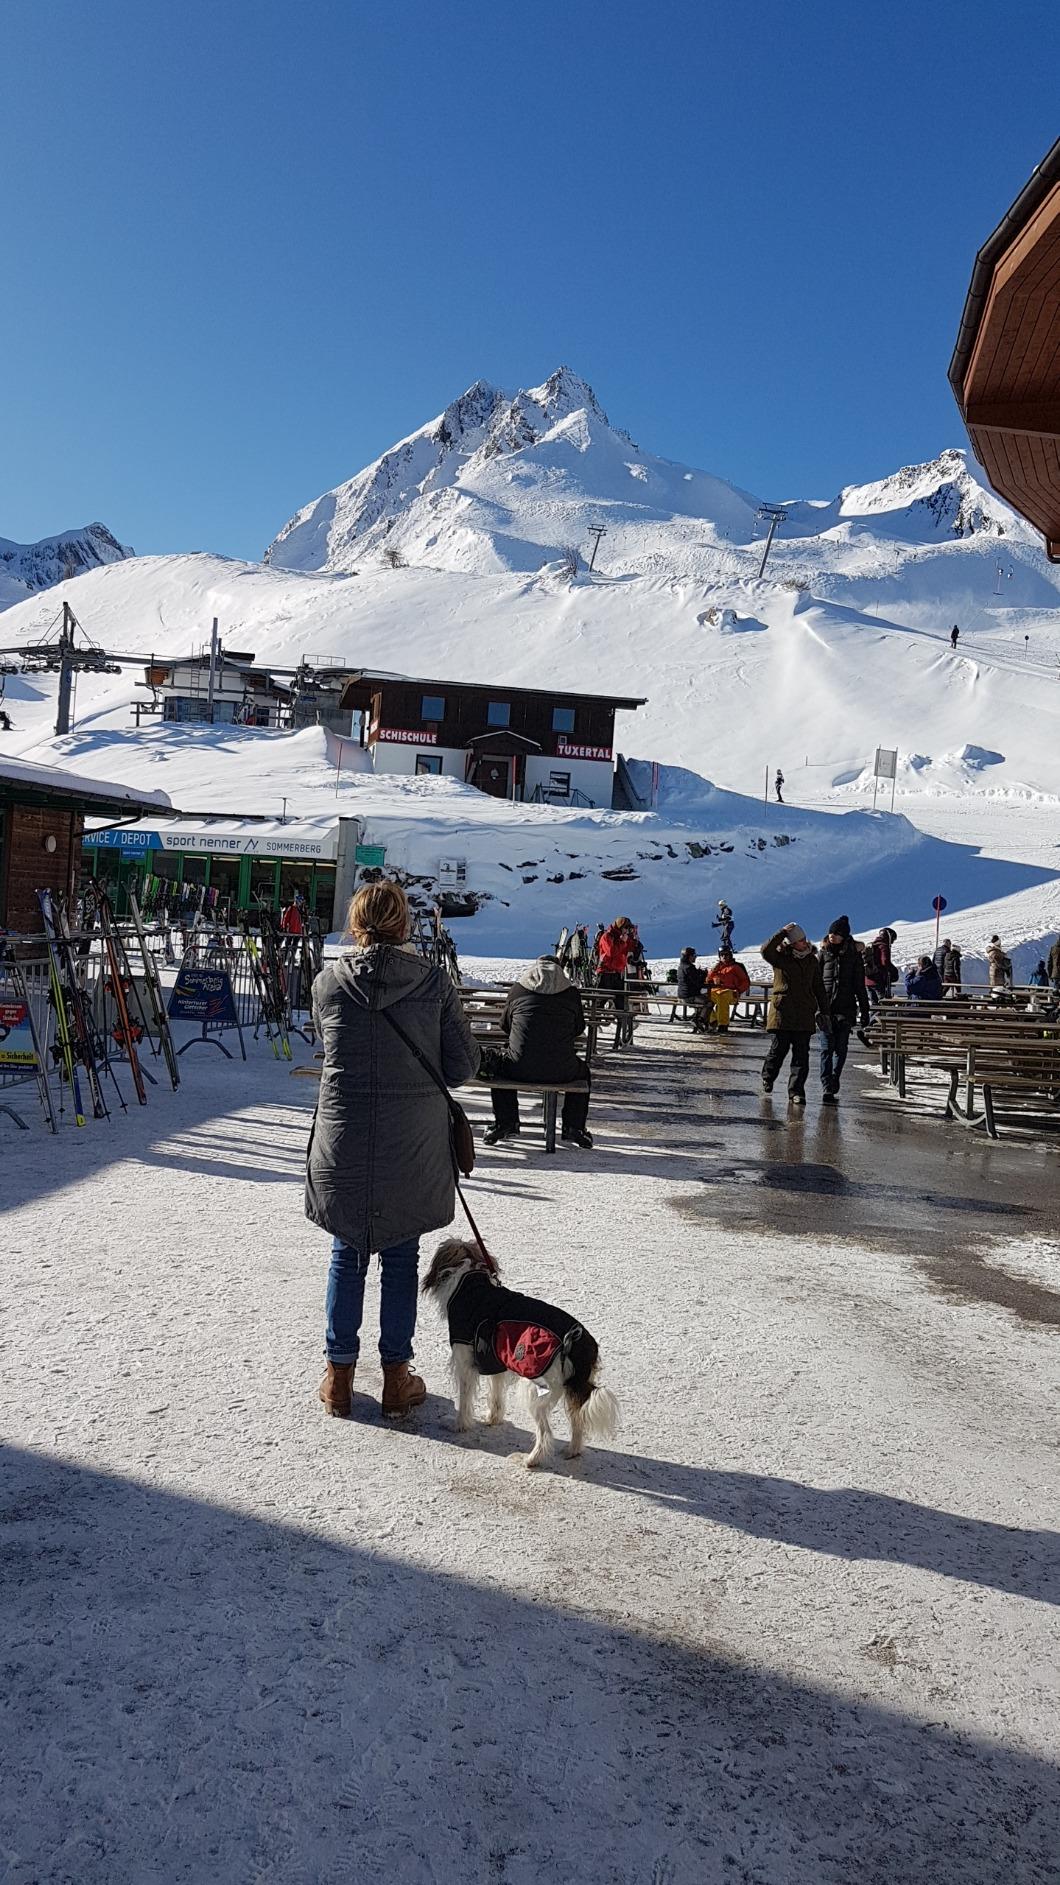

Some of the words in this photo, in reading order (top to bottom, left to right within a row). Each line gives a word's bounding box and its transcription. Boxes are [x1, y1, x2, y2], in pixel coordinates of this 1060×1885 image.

[379, 730, 438, 745] SCHISCHULE
[557, 744, 611, 760] TUXERTAL
[82, 832, 110, 844] RVICE
[121, 833, 152, 846] DEPOT
[166, 836, 196, 848] sport
[199, 838, 242, 850] nenner
[266, 841, 322, 855] SOMMERBERG
[6, 1052, 34, 1061] Sicherheit
